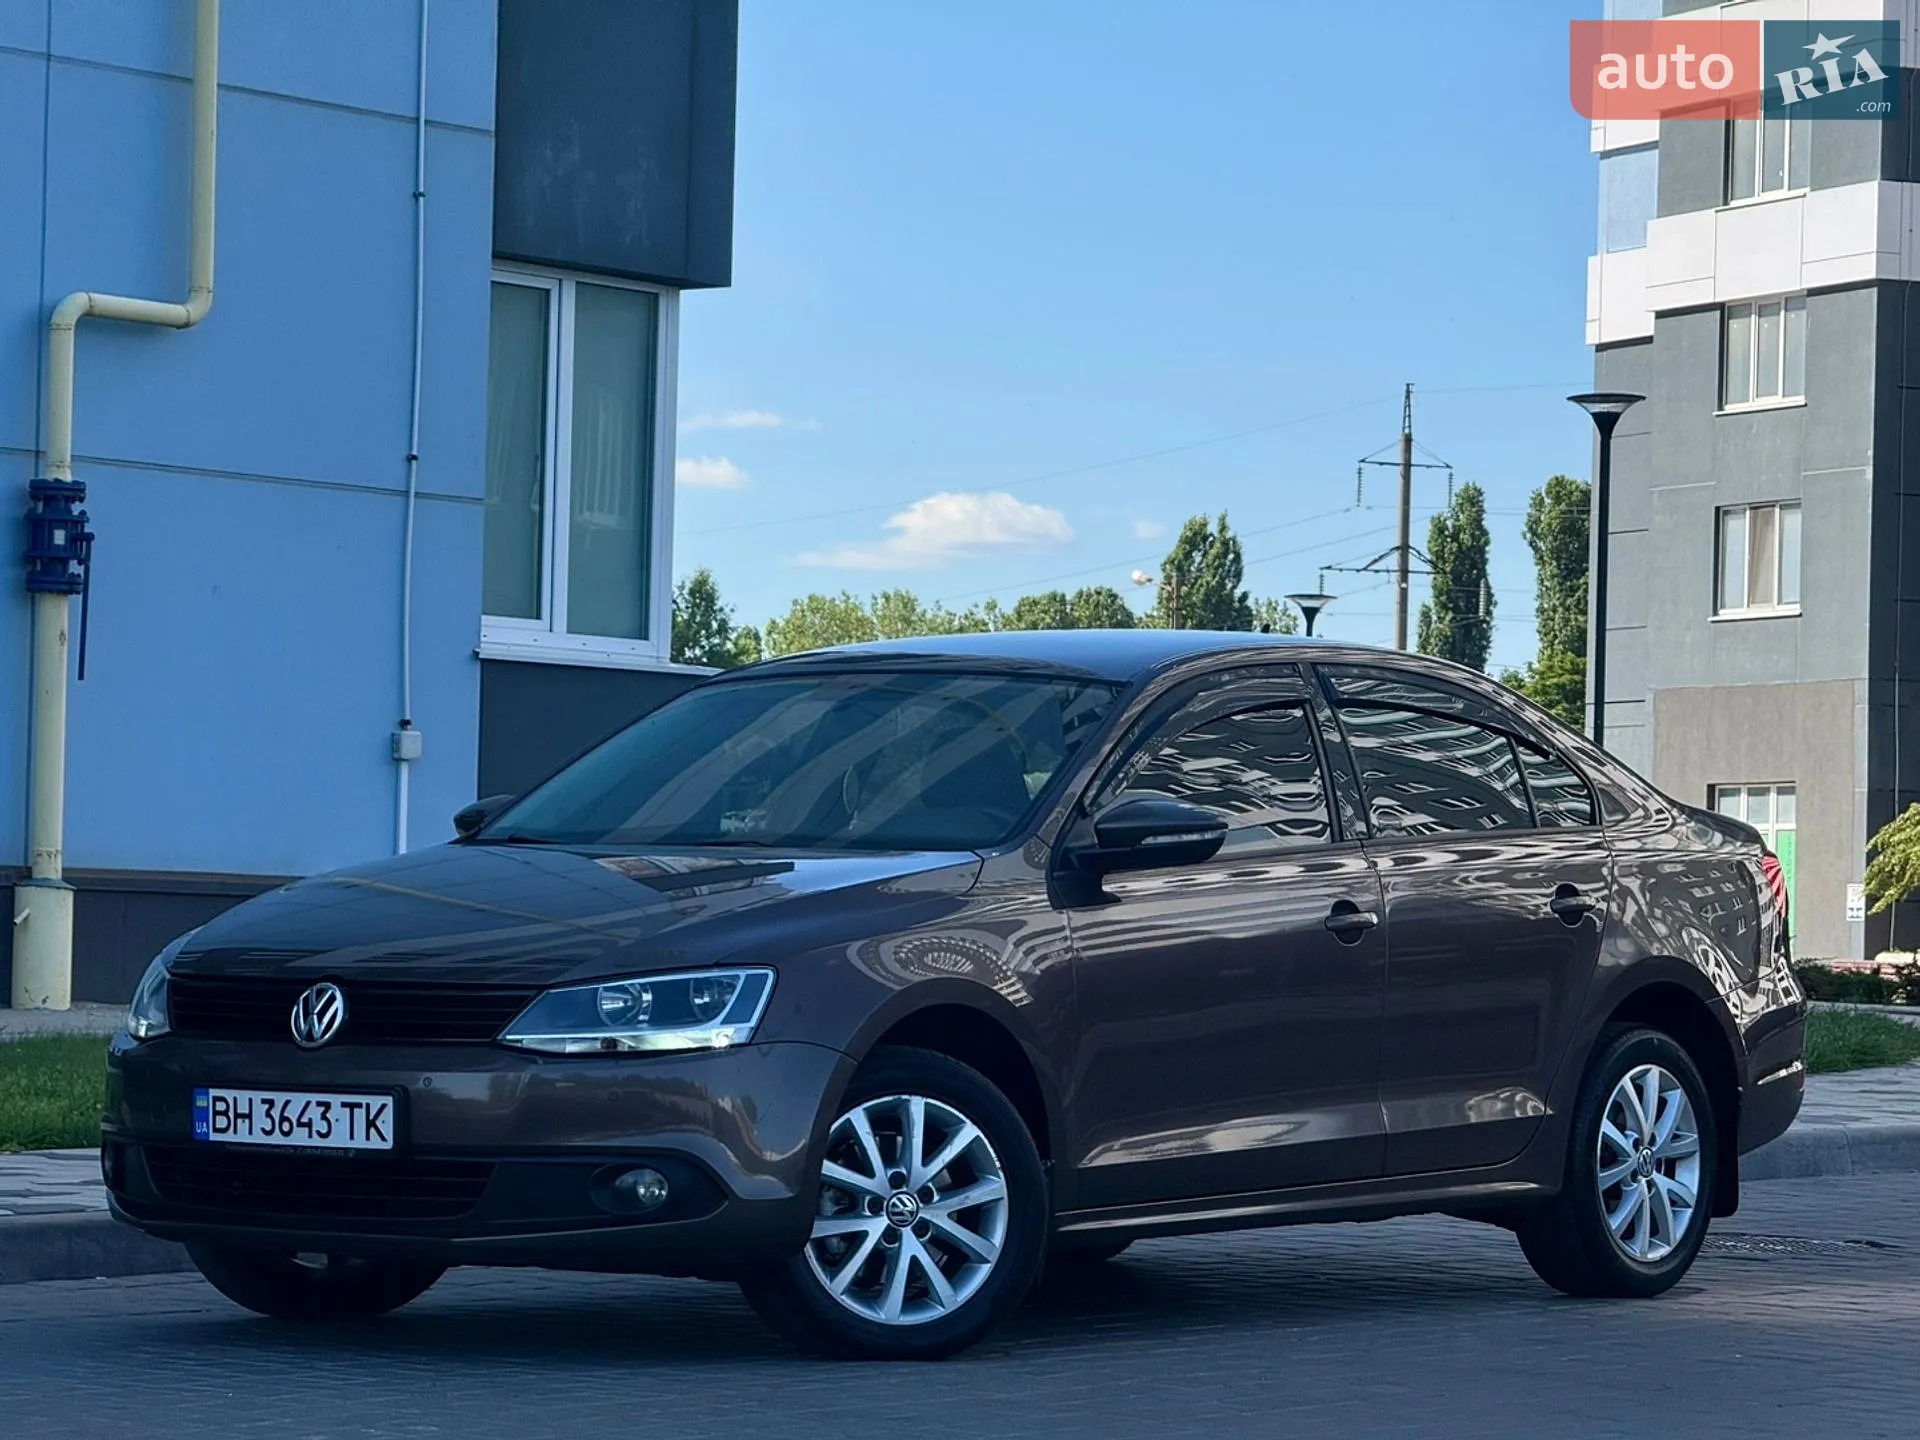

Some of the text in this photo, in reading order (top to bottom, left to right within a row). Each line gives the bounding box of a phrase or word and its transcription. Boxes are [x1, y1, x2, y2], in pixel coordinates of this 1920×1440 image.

[195, 1121, 208, 1133] UA
[212, 1095, 388, 1142] BH 3643 TK
